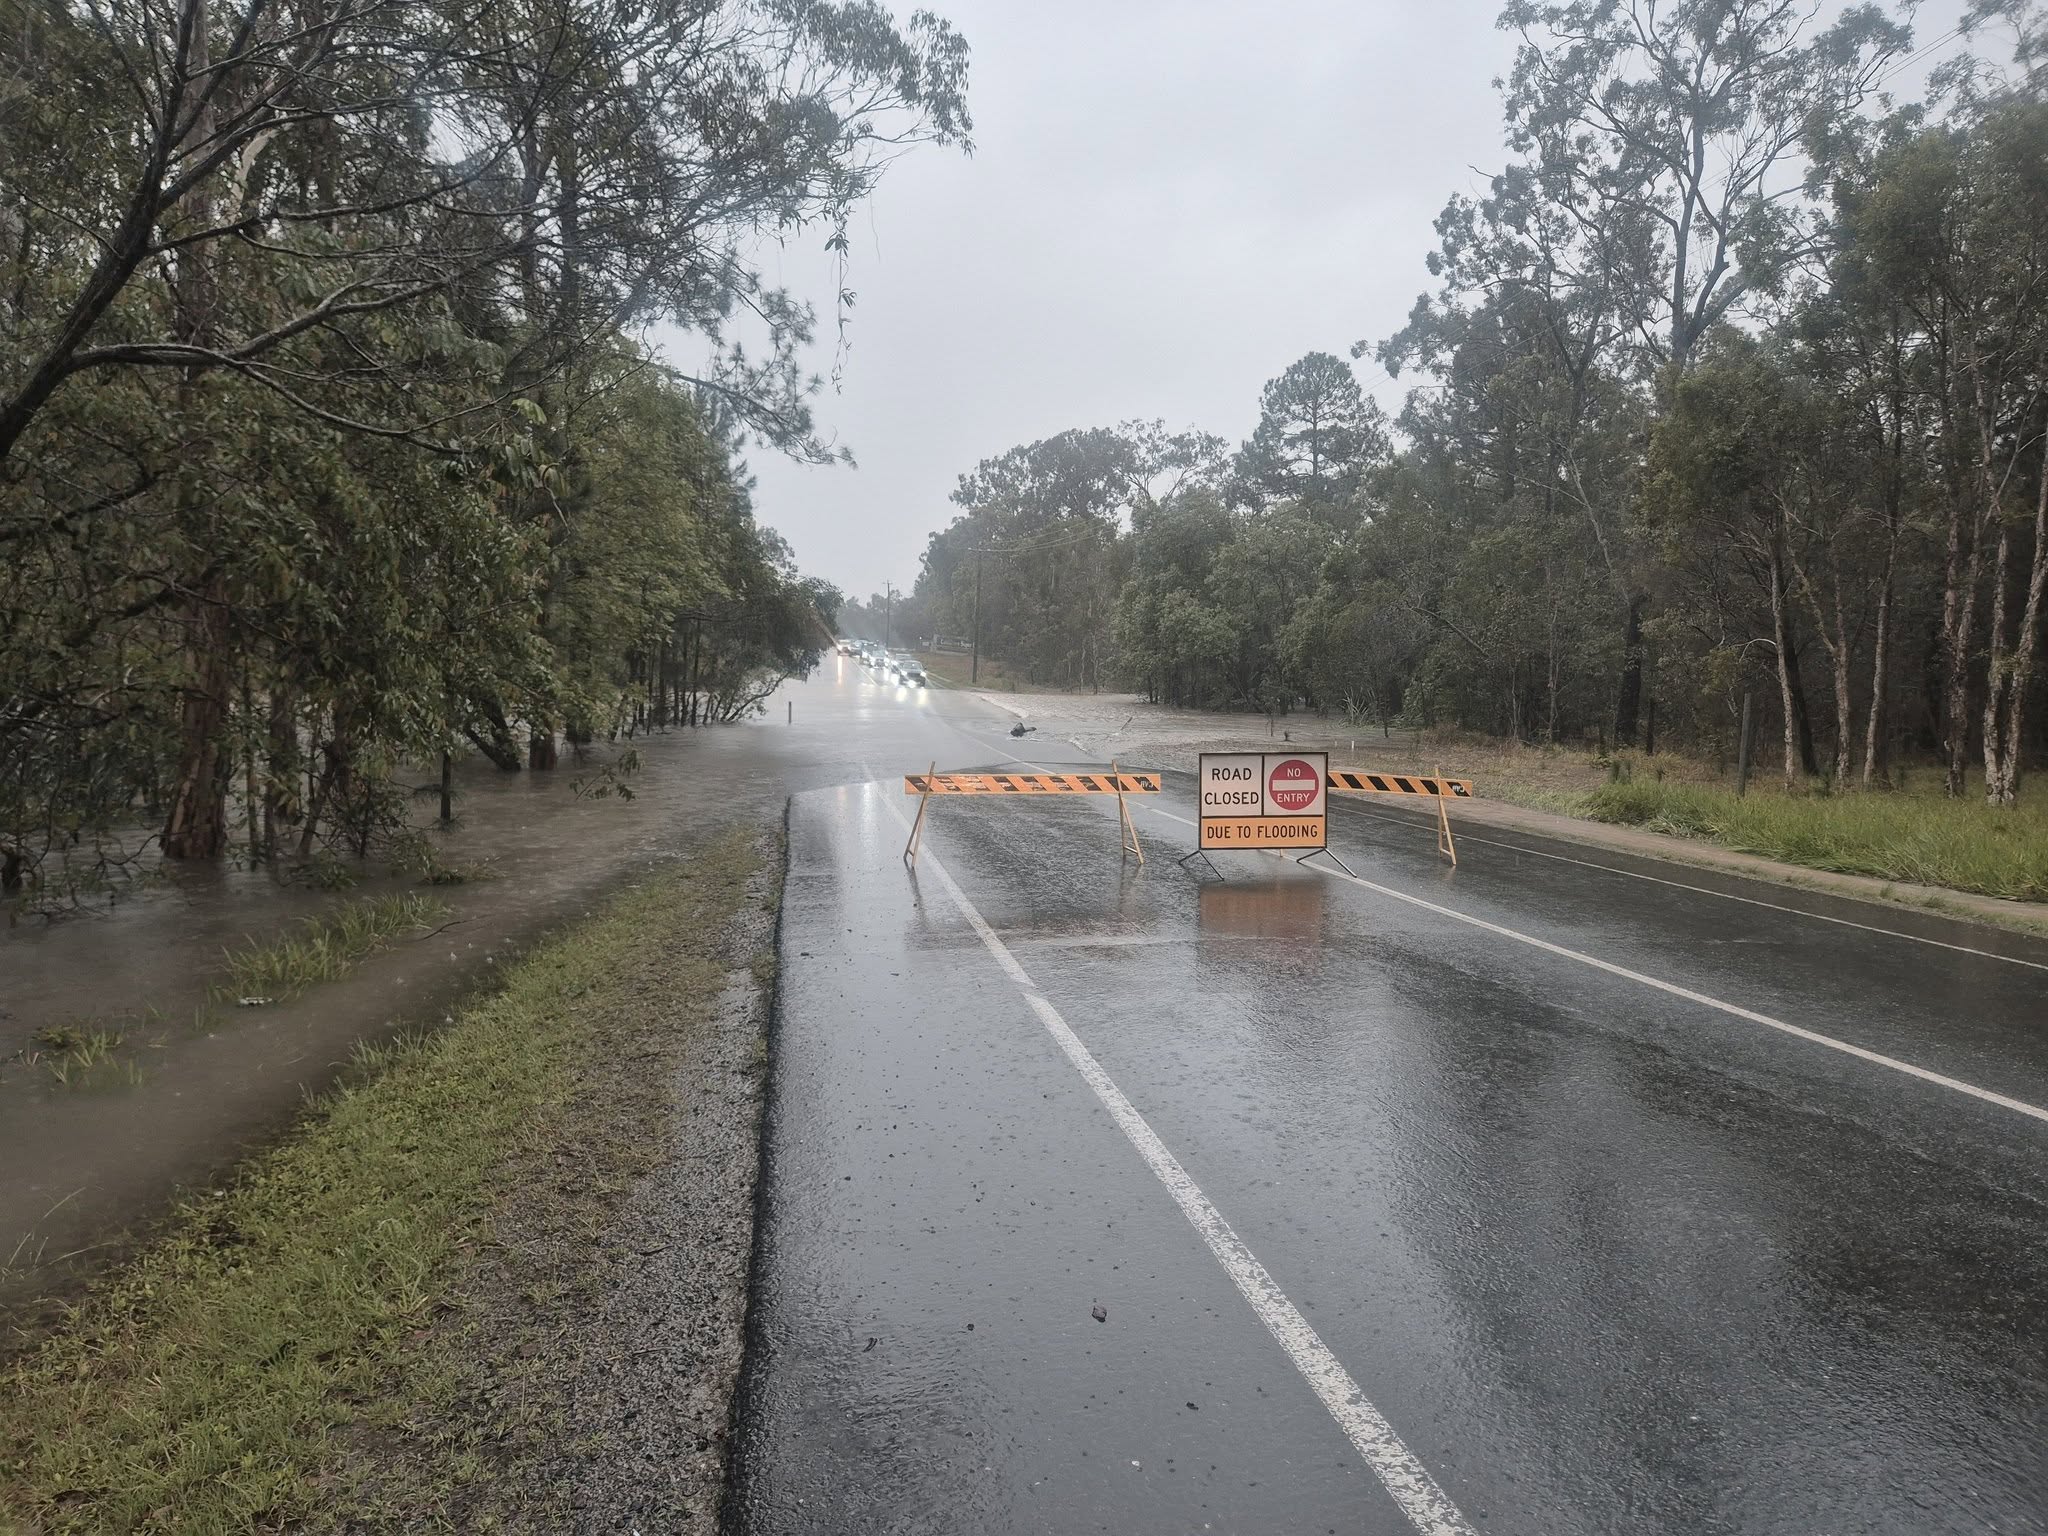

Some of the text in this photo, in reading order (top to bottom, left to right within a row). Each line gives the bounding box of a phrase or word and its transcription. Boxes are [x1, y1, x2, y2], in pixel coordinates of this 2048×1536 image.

[1211, 767, 1252, 781] ROAD
[1286, 767, 1301, 778] NO
[1204, 792, 1259, 805] CLOSED
[1277, 793, 1310, 803] ENTRY
[1207, 824, 1318, 839] DUE TO FLOODING
